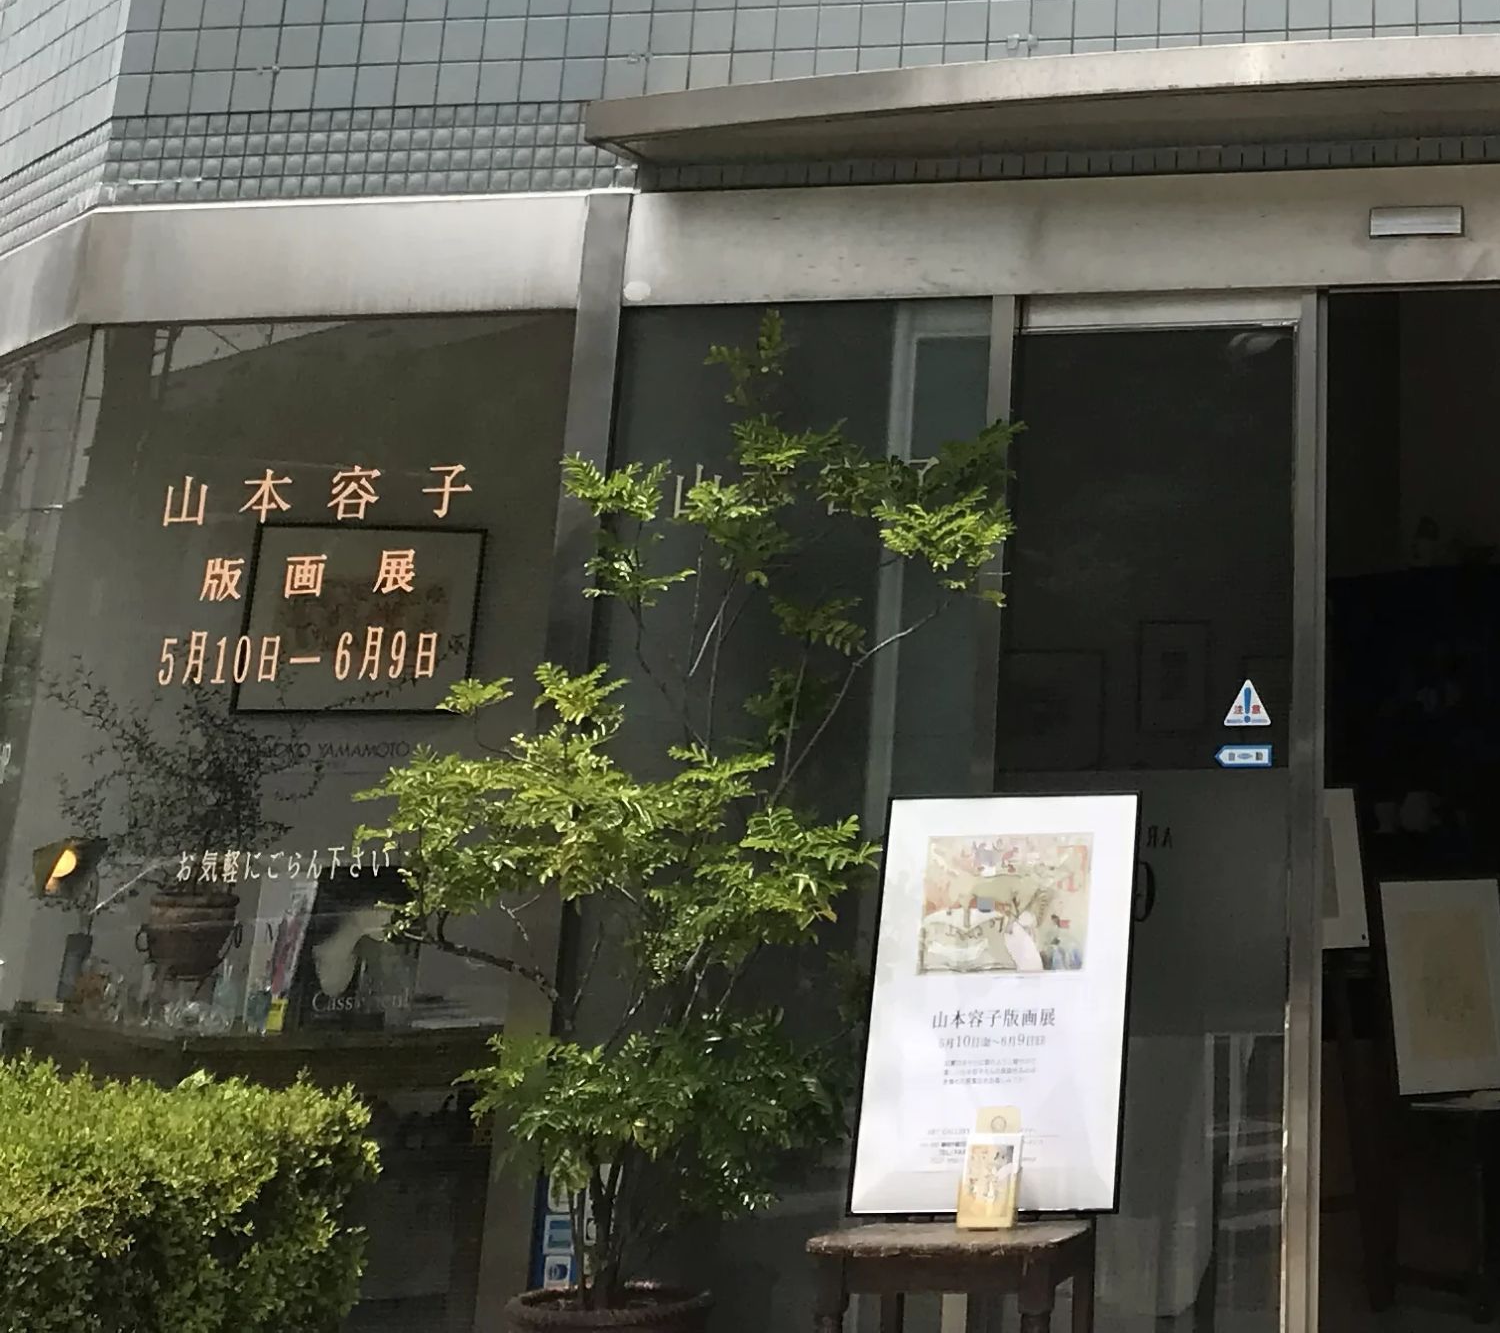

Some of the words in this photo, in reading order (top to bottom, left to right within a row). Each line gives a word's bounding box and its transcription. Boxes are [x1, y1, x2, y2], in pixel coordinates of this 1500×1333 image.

[162, 464, 473, 527] 山本容子
[200, 548, 417, 601] 版画展
[932, 1008, 1056, 1029] 山本容子版画展
